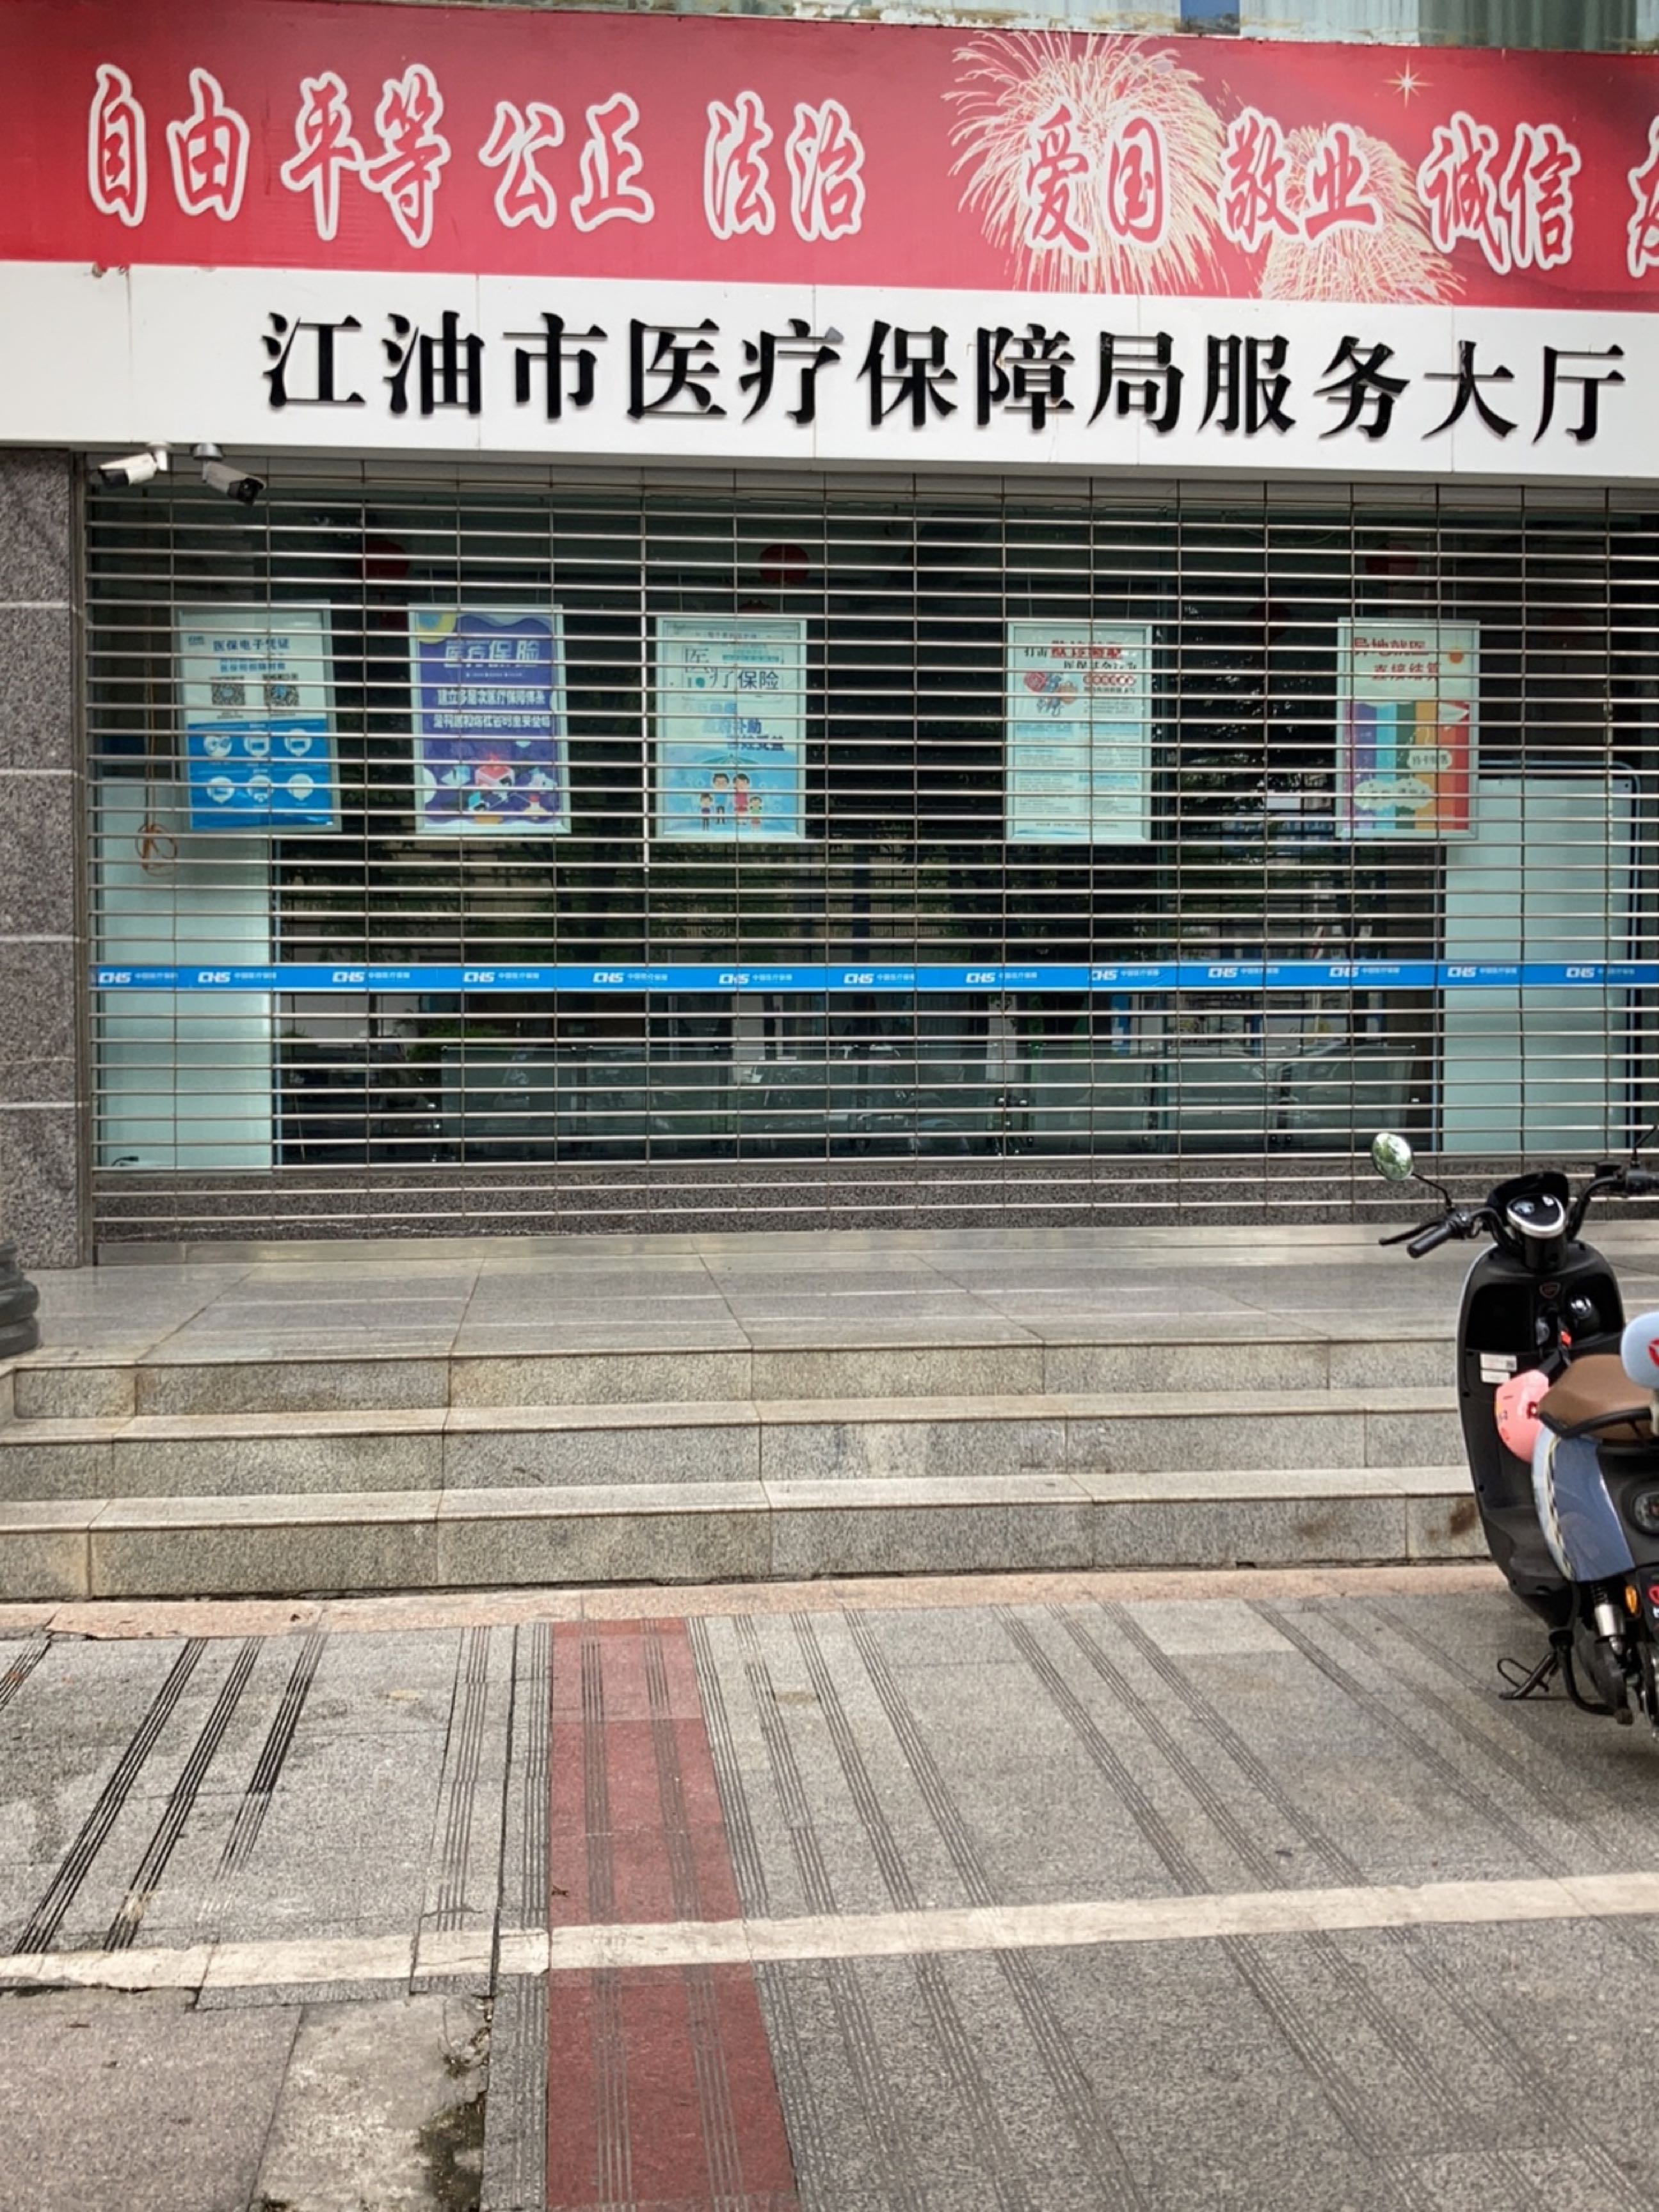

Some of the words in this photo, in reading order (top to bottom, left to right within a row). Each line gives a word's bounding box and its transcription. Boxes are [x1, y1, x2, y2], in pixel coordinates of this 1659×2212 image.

[88, 63, 250, 227] 自由
[280, 63, 452, 249] 平等
[479, 92, 655, 233] 公正
[705, 90, 866, 242] 法治
[1020, 97, 1173, 262] 爱国
[1217, 106, 1386, 254] 敬业
[1417, 110, 1583, 276] 诚信
[261, 310, 1626, 445] 江油市医疗保障局服务大厅
[198, 972, 230, 982] CHS
[463, 972, 495, 982] CHS
[1208, 967, 1237, 978] CHS
[1447, 966, 1477, 977] CHS
[1566, 966, 1594, 978] CHS
[99, 972, 132, 983] CHS
[332, 972, 365, 983] CHS
[593, 972, 624, 983] CHS
[844, 973, 874, 984] CHS
[966, 972, 995, 983] CHS
